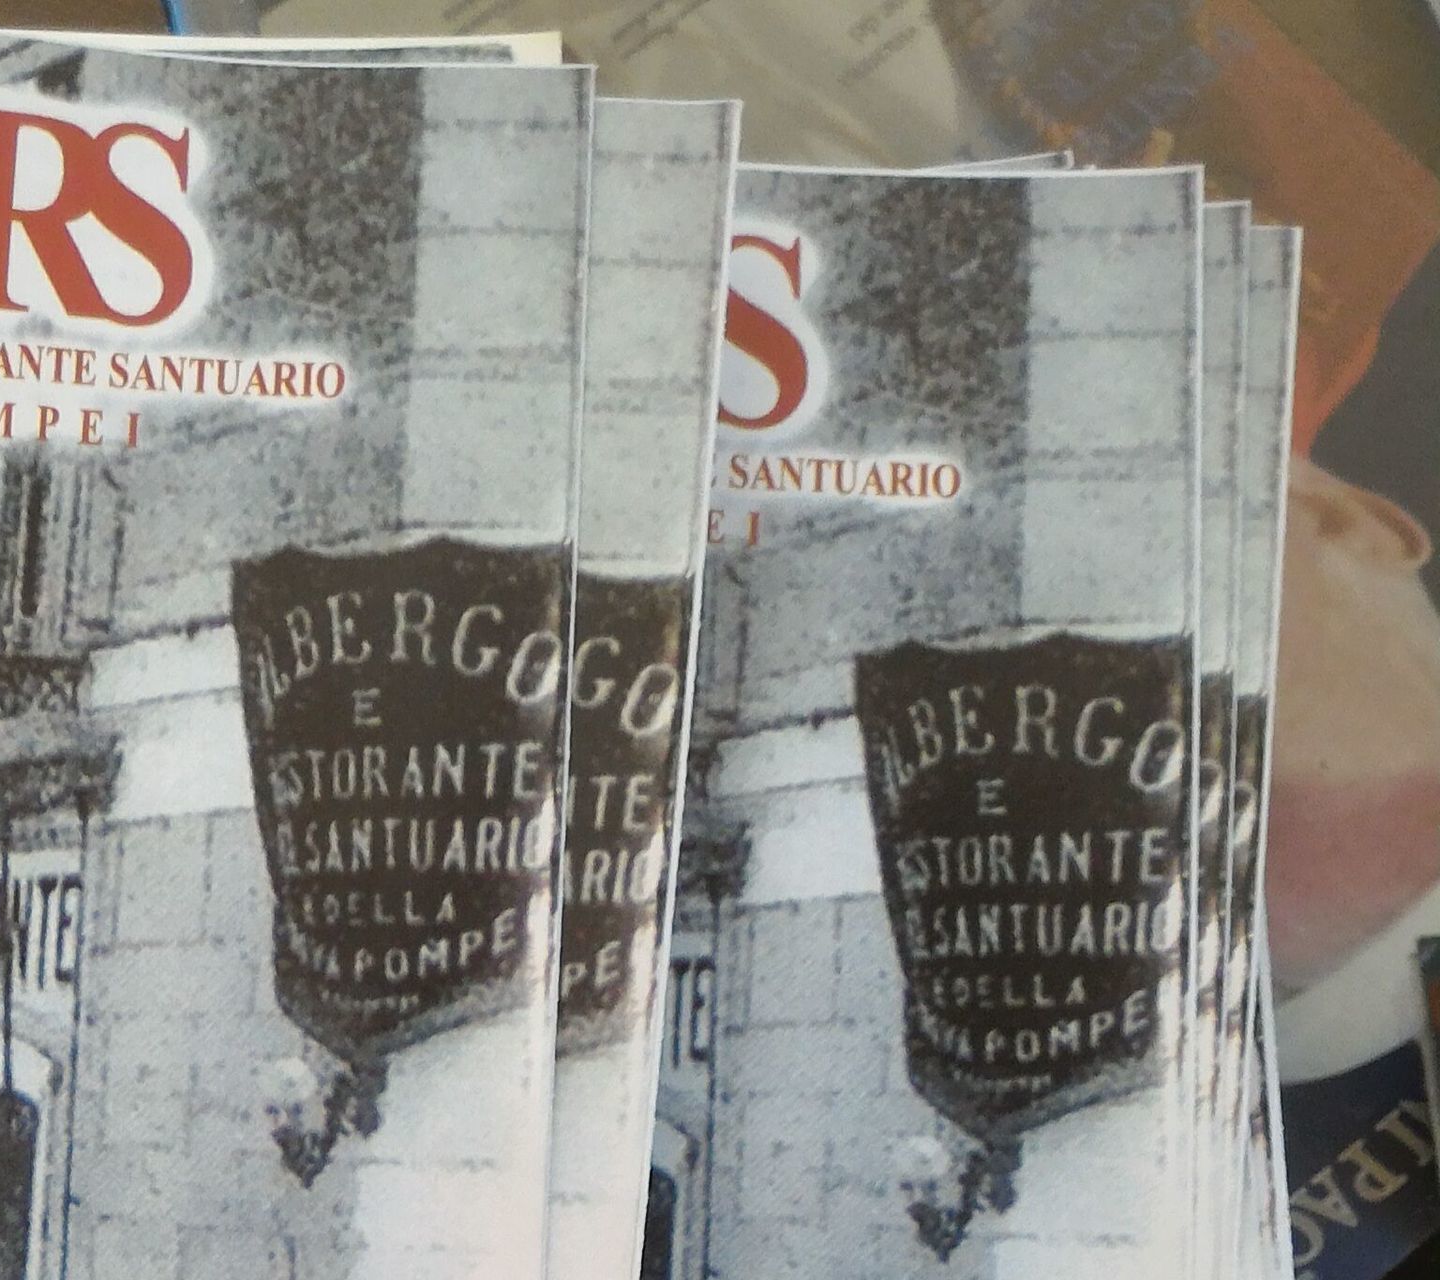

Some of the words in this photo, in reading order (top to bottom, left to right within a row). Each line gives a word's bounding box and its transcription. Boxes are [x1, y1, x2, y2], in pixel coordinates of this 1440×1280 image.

[108, 354, 347, 399] SANTUARIO
[729, 455, 961, 498] SANTUARIO
[352, 688, 381, 725] E
[977, 778, 1008, 816] E
